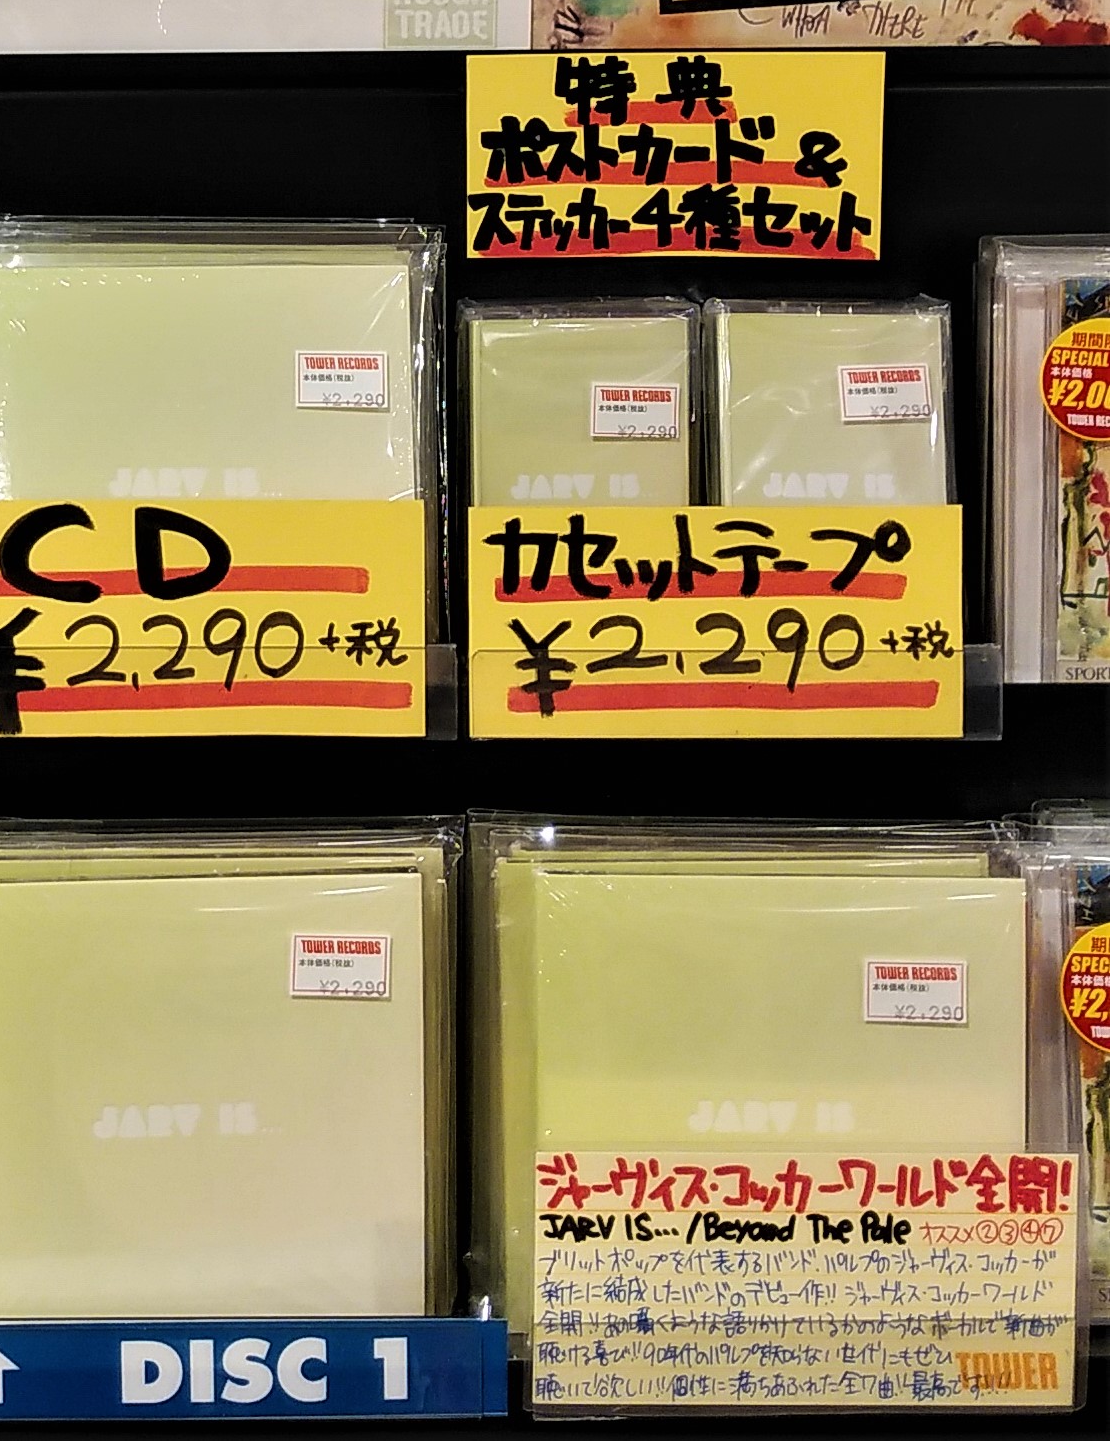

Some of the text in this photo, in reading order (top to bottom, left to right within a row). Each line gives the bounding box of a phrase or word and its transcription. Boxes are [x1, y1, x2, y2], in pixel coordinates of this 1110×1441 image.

[394, 9, 488, 39] TRADE
[481, 115, 849, 188] ポストカード &
[304, 356, 380, 370] TOWER RECORDS
[1051, 349, 1110, 366] SPECIAL
[848, 369, 922, 384] TOWER RECORDS
[1050, 367, 1093, 379] 本体価格
[600, 389, 672, 403] TOWER RECORDS
[482, 513, 912, 601] カセットテープ
[1065, 666, 1110, 681] SPOR
[301, 939, 382, 955] TOWER RECORDS
[1091, 936, 1110, 953] 期
[1070, 955, 1110, 973] SPEC
[875, 966, 957, 981] TOWER RECORDS
[539, 1214, 615, 1243] JARV
[806, 1213, 854, 1244] The
[860, 1210, 912, 1245] Pale
[120, 1336, 409, 1404] DISC 1
[955, 1352, 1058, 1390] TOWER
